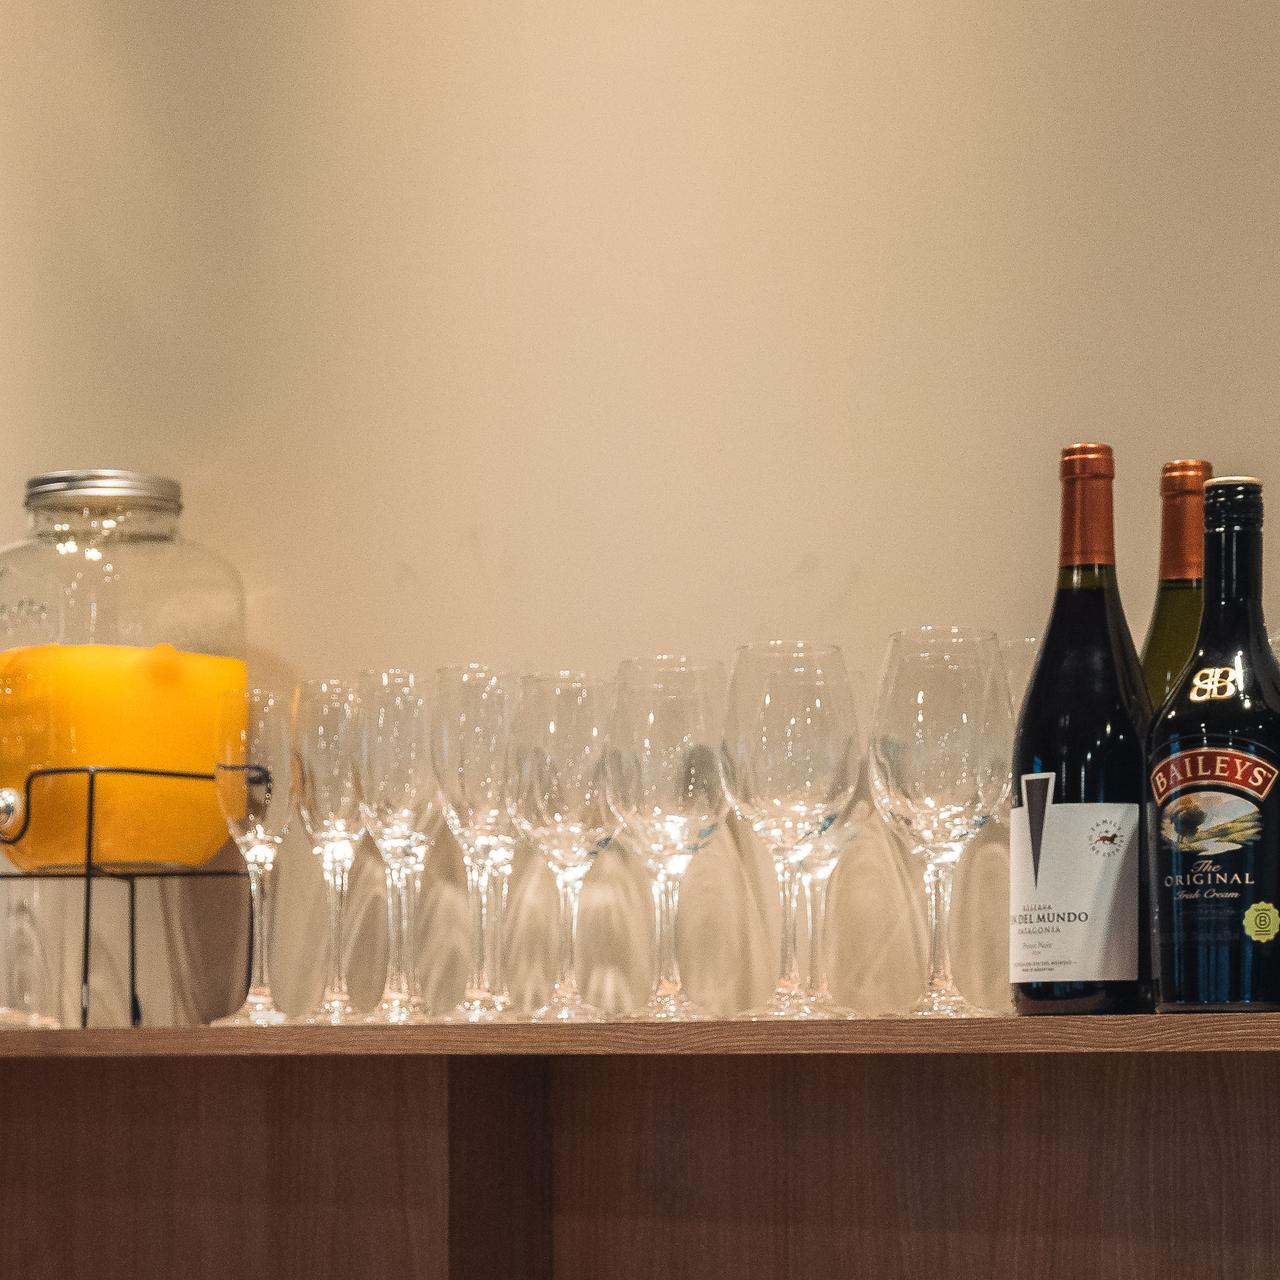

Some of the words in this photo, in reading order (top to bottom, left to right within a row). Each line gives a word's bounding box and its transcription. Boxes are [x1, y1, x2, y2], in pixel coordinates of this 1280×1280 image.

[1155, 755, 1268, 793] BAILEYS
[1190, 859, 1223, 874] The
[1163, 871, 1256, 888] ORIGINAL
[1203, 887, 1241, 899] Cream
[1036, 911, 1089, 924] MUNDO
